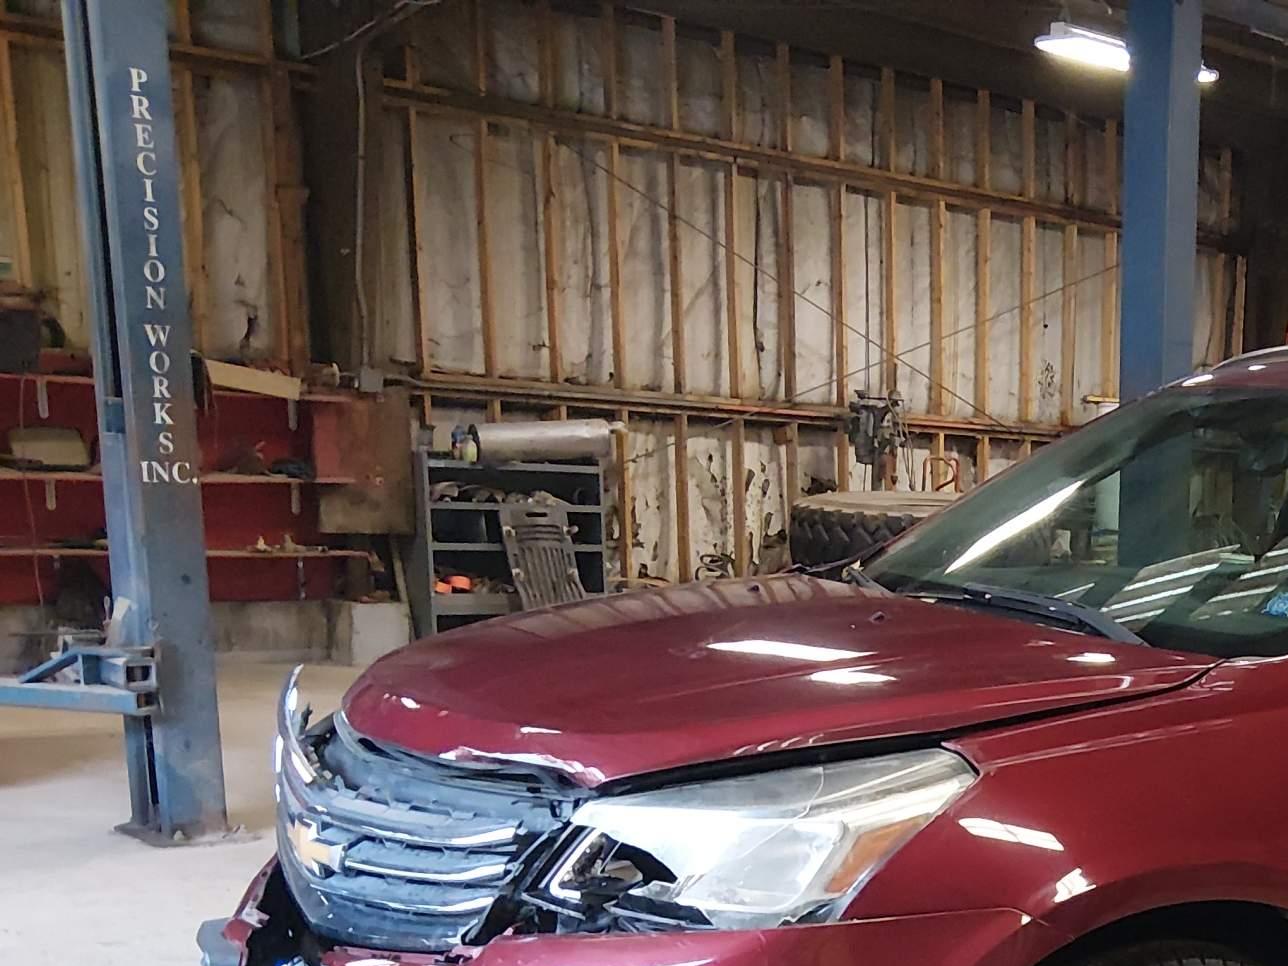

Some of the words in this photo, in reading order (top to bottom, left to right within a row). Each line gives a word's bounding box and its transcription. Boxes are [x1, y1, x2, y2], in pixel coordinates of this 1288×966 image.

[128, 66, 166, 311] PRECISION
[143, 323, 175, 455] WORKS
[139, 460, 199, 485] INC.
